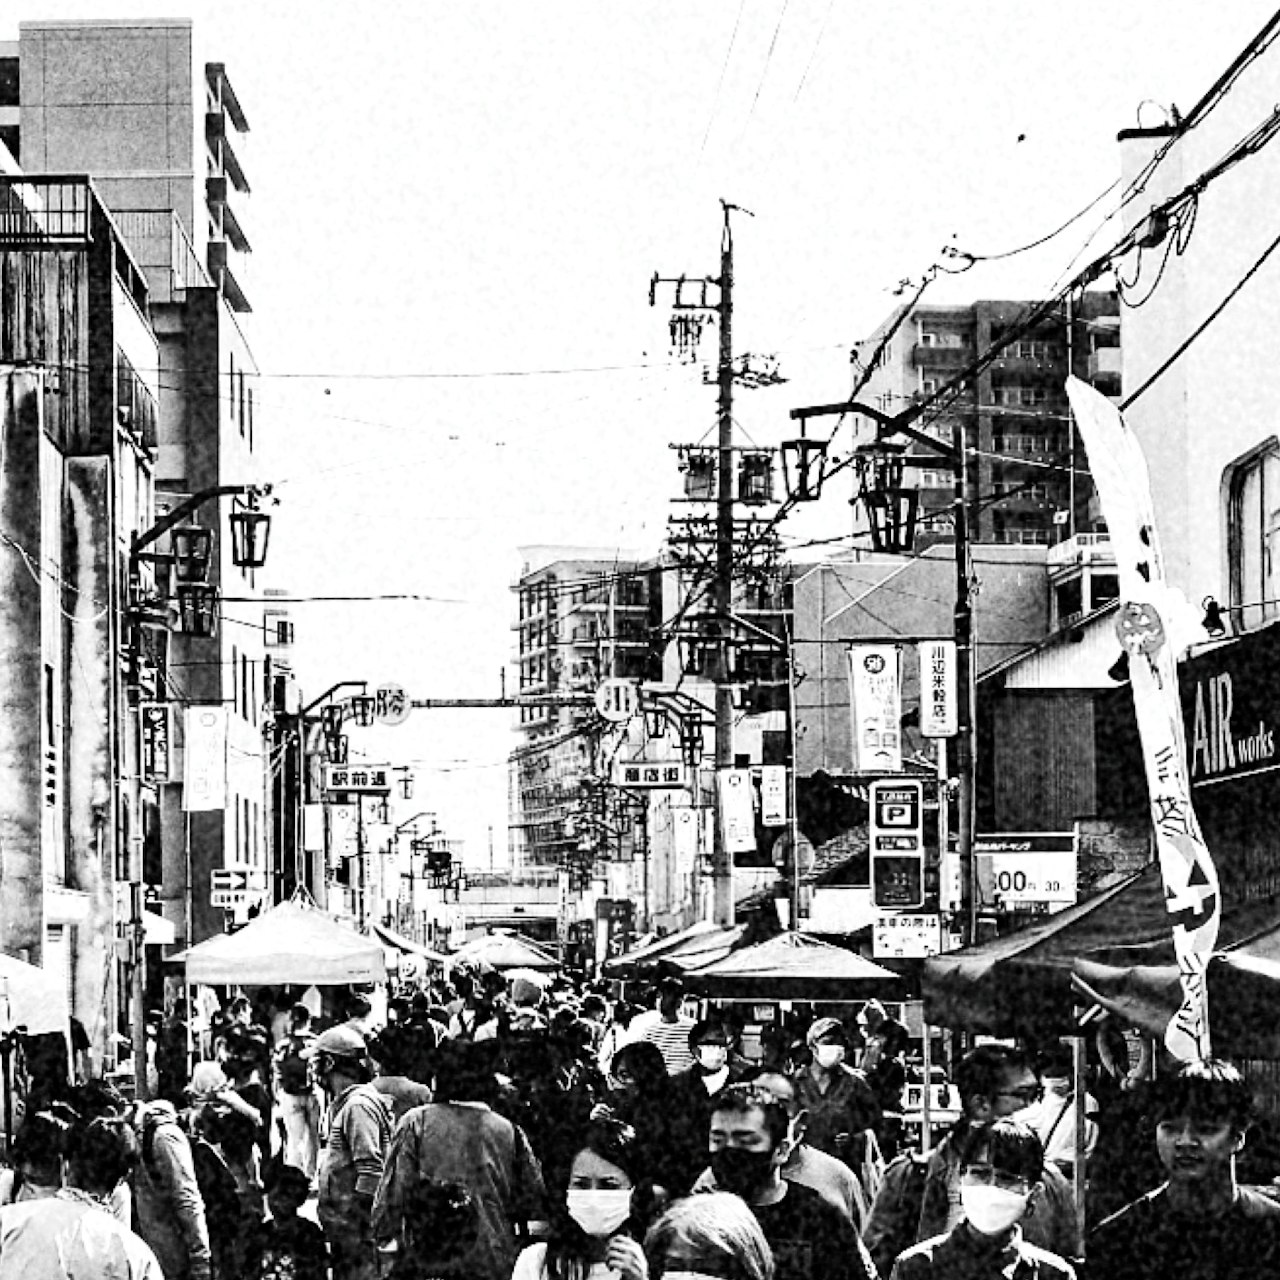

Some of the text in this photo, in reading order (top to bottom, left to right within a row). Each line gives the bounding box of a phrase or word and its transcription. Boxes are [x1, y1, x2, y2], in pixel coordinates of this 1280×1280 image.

[1191, 671, 1275, 777] AIR works
[332, 771, 386, 786] 駅前通
[887, 806, 906, 822] P
